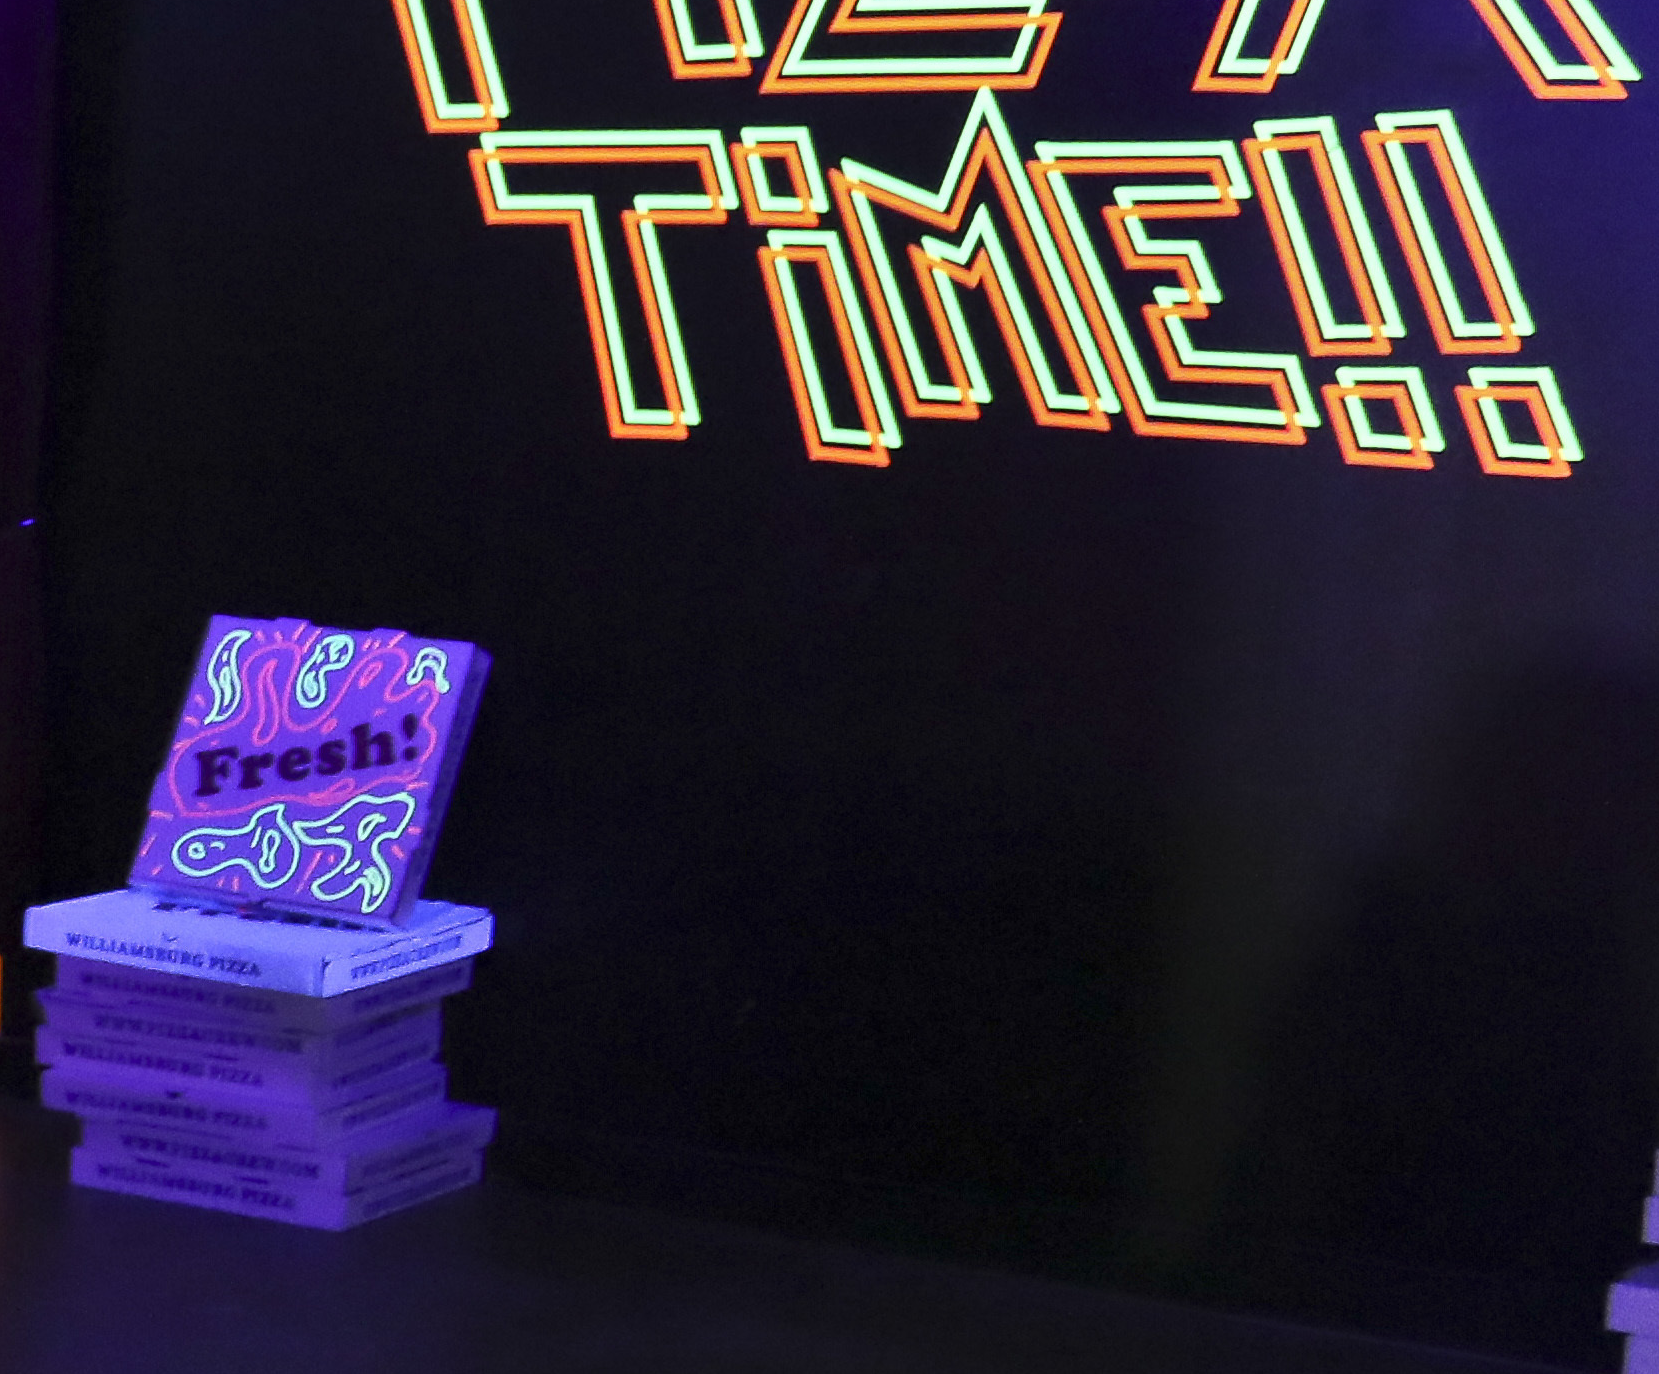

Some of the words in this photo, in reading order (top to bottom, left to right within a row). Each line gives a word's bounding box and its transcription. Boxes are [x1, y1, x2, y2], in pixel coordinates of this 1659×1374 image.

[193, 713, 420, 797] Fresh!
[66, 932, 205, 968] WILLIAMSBURG
[209, 955, 262, 976] PIZZA
